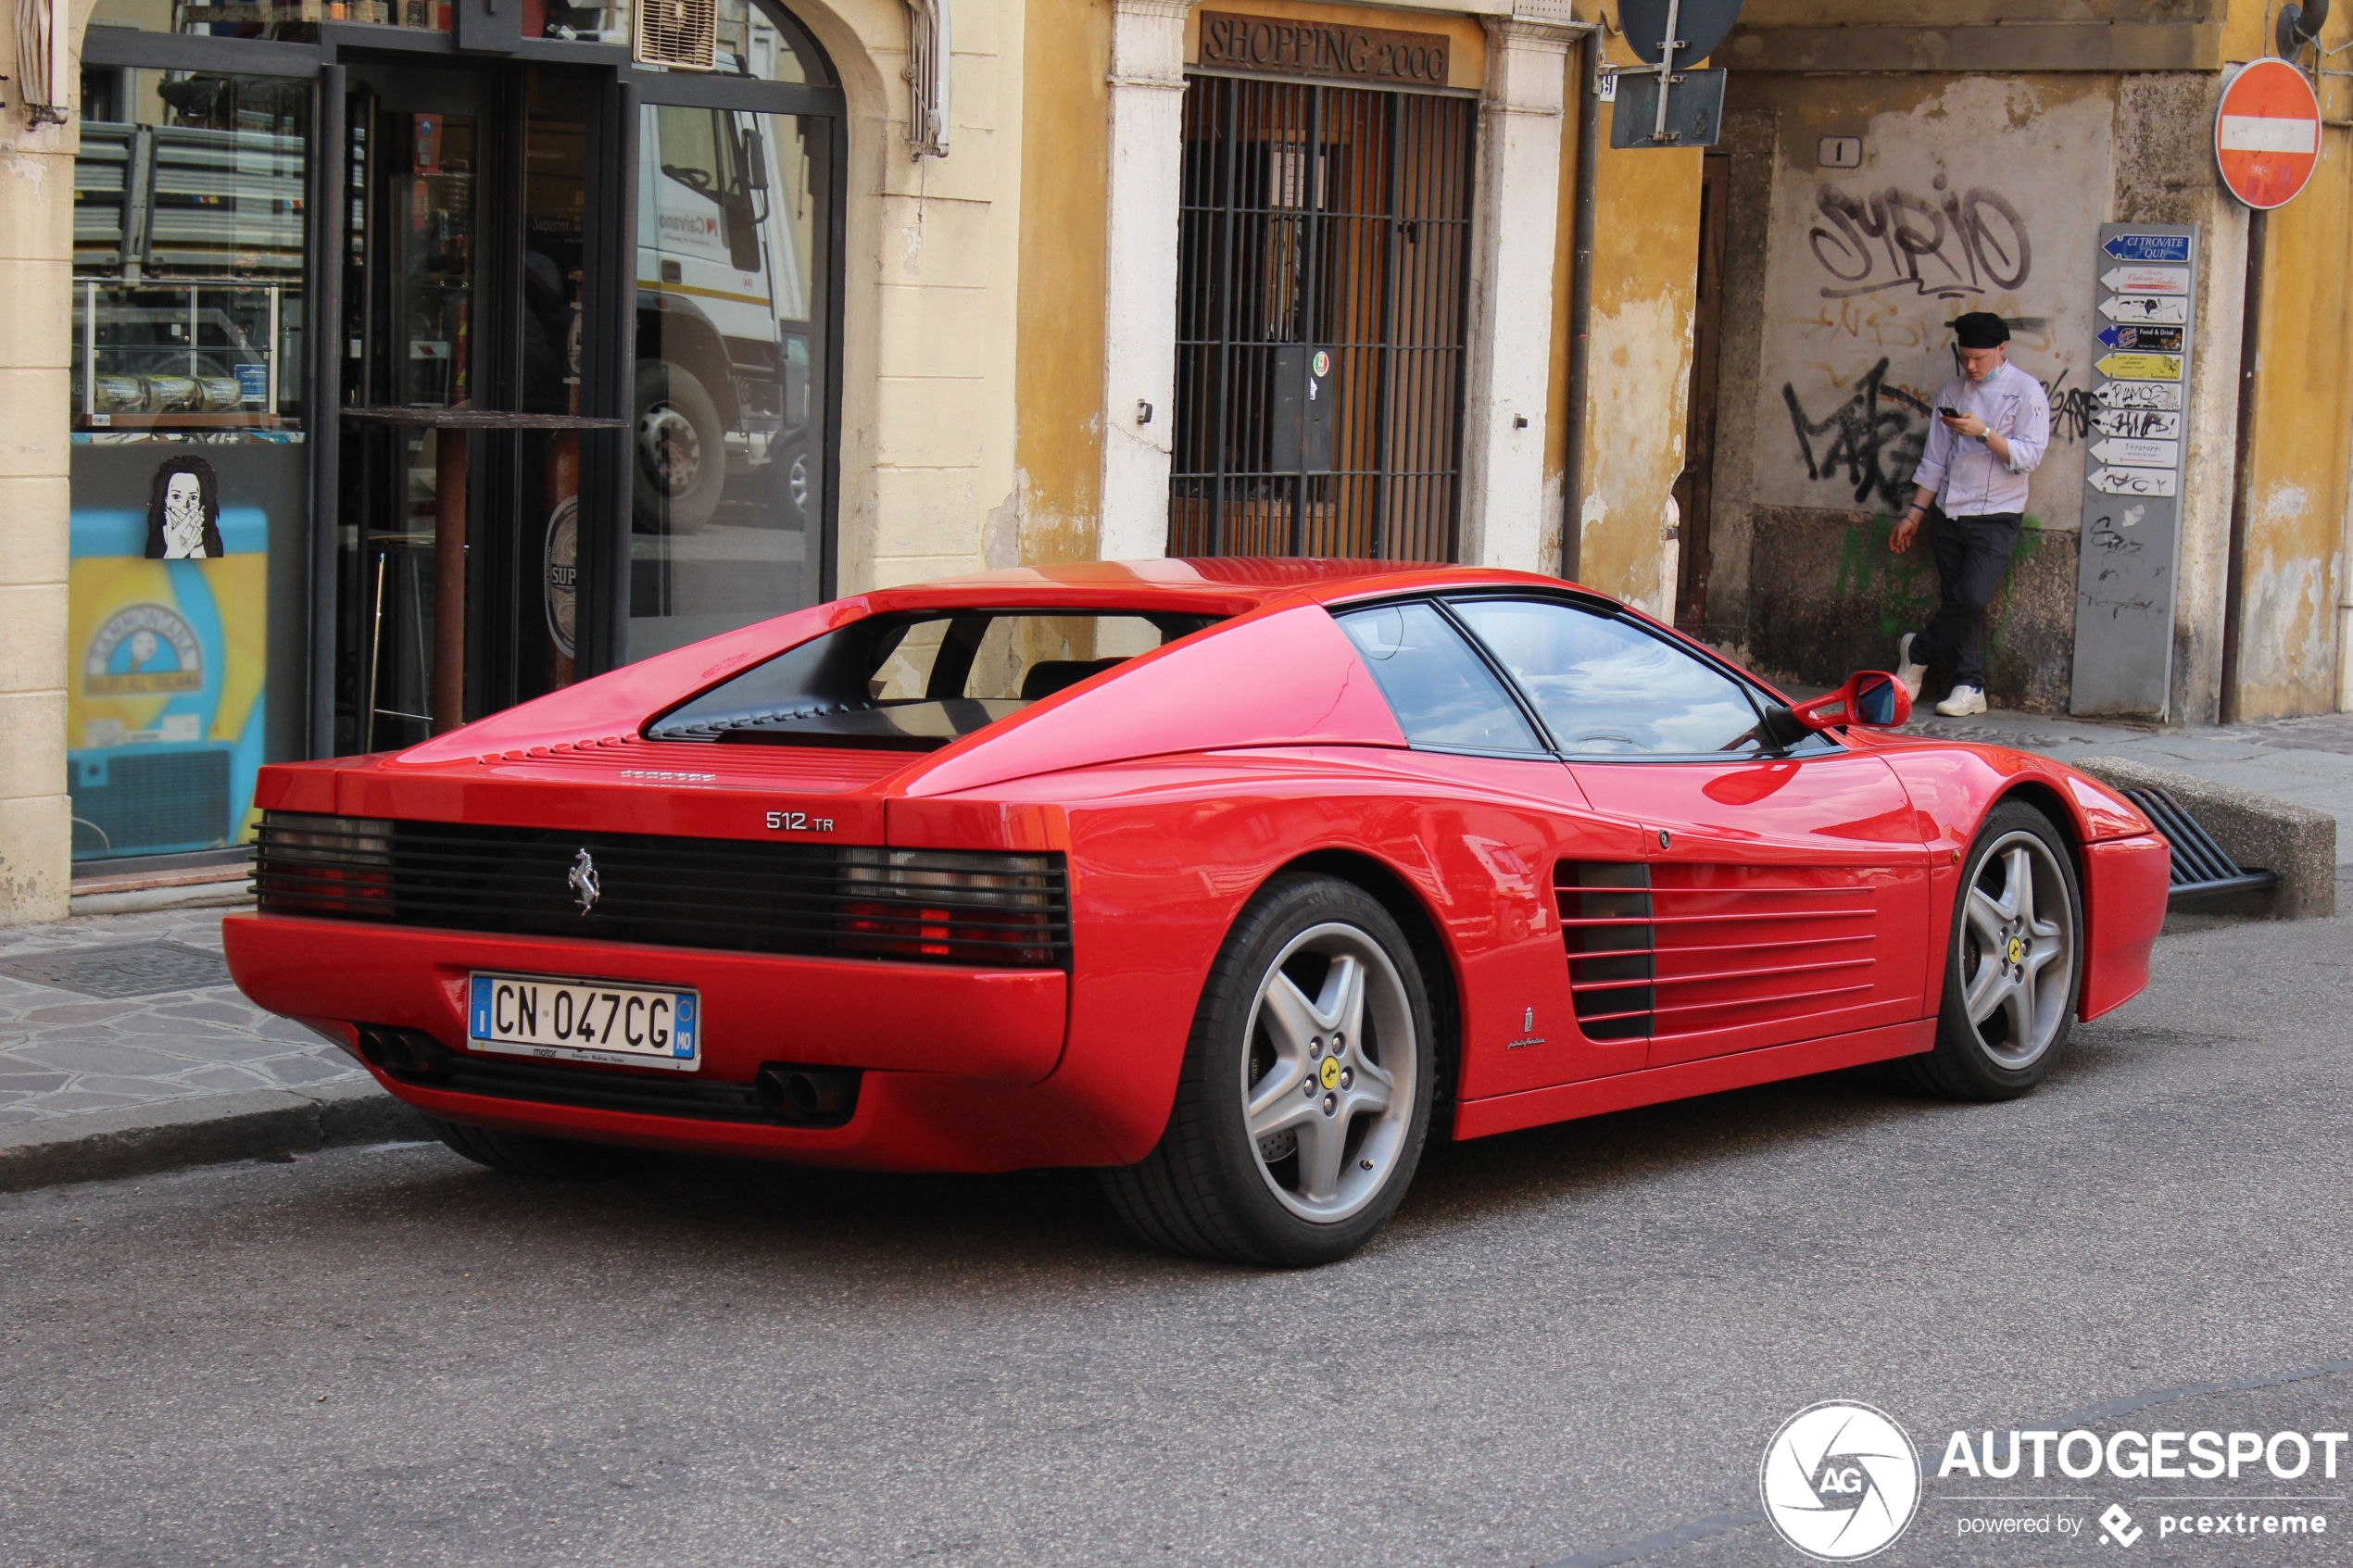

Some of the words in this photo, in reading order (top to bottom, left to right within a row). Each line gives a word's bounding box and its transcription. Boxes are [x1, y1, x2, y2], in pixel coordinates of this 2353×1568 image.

[1206, 19, 1370, 74] SHOPPING
[1378, 42, 1443, 80] 2000
[1835, 141, 1843, 162] 1
[2127, 237, 2138, 246] CI
[2140, 237, 2183, 247] TROVATE
[2145, 249, 2164, 258] QUI
[766, 811, 807, 830] 512
[812, 819, 834, 832] TR
[479, 1010, 485, 1033] I
[495, 985, 537, 1037] CN
[553, 990, 669, 1049] 047CG
[676, 1031, 691, 1051] MO
[533, 1047, 557, 1058] motor
[571, 1052, 589, 1061] Bologna
